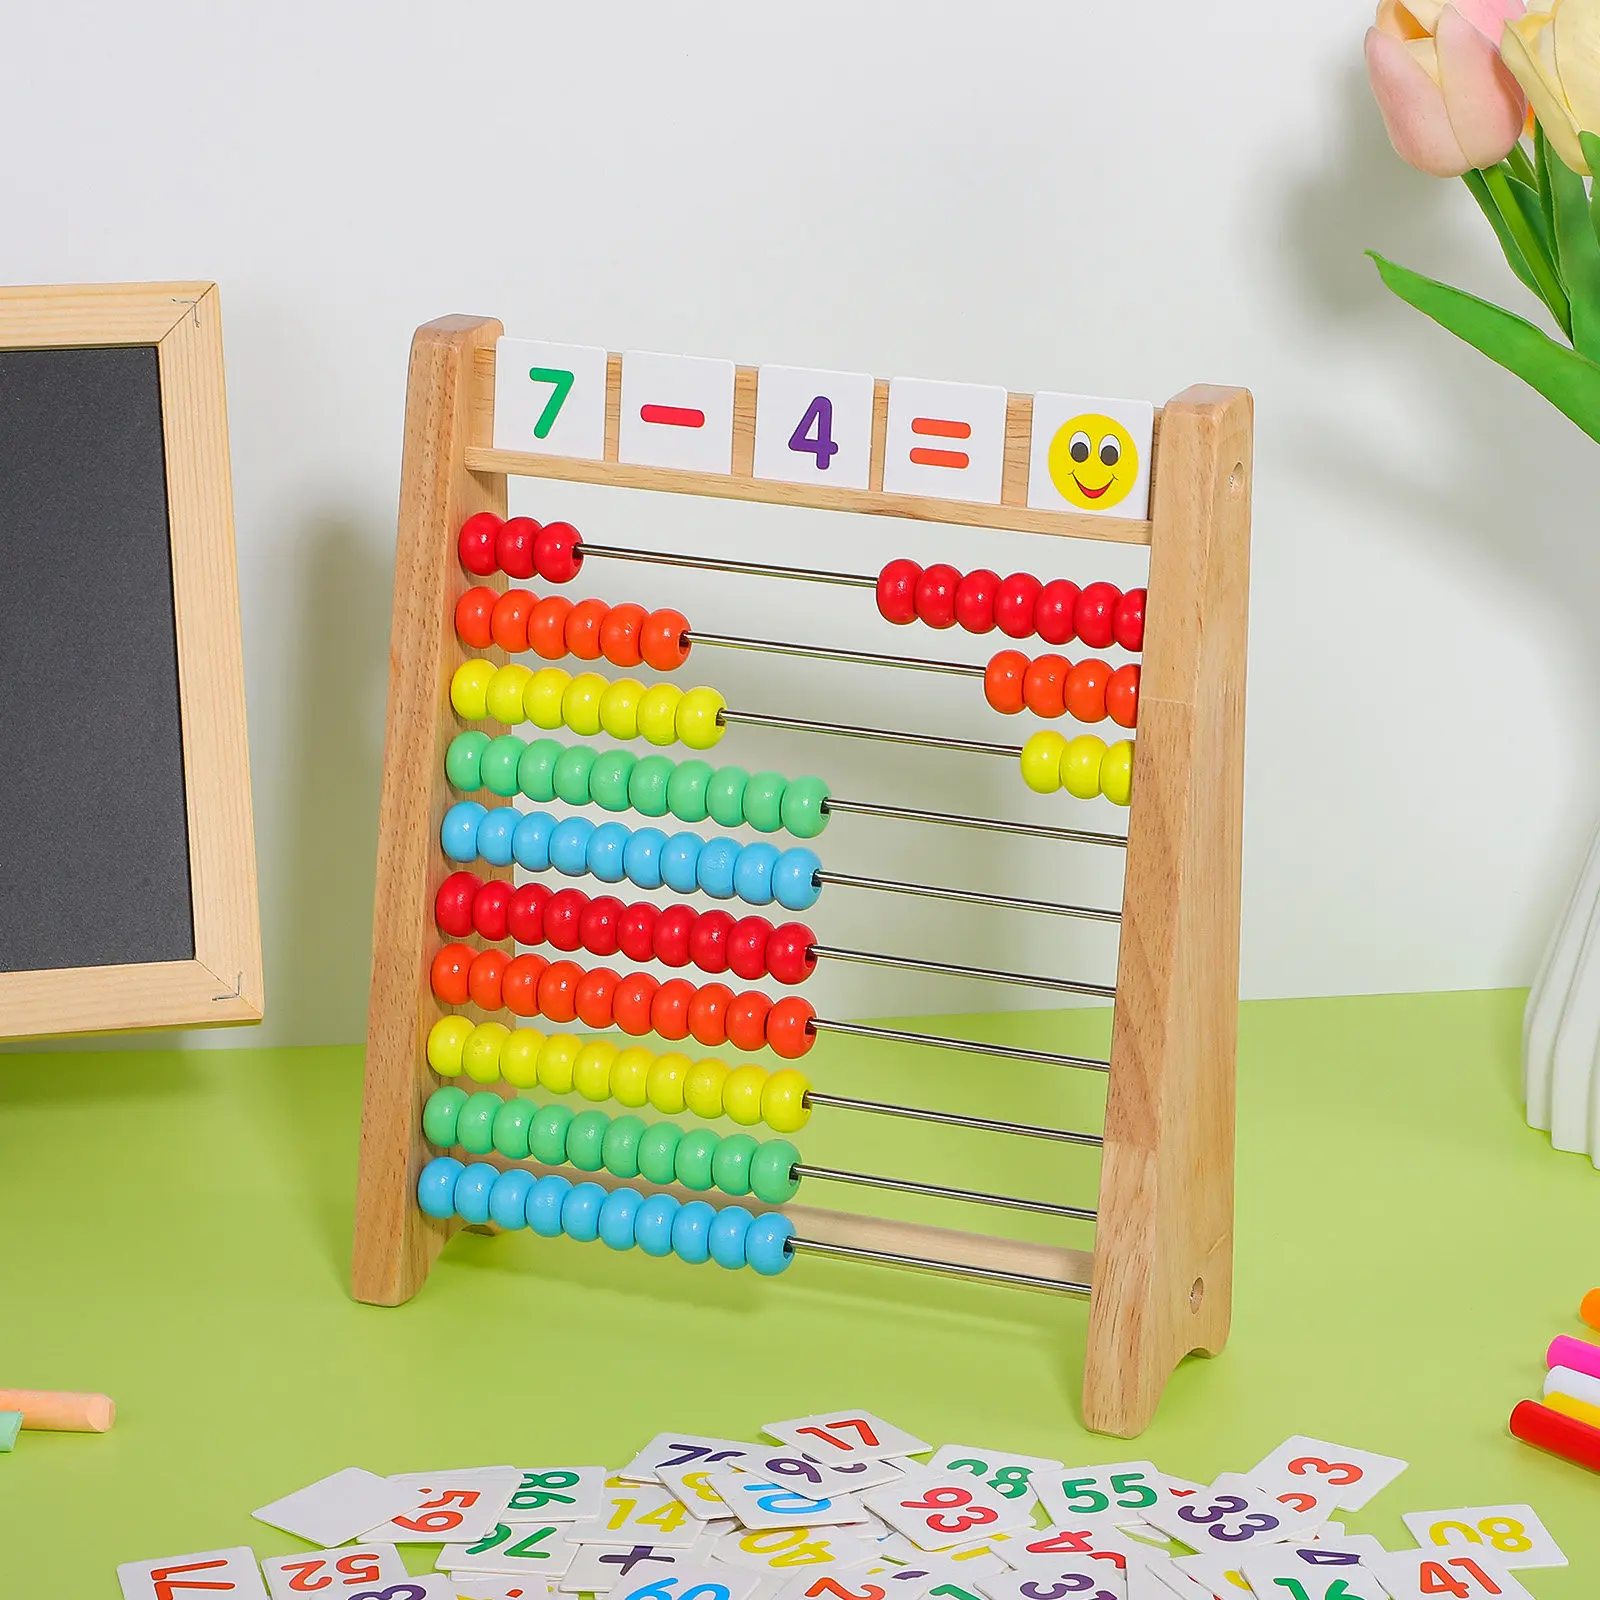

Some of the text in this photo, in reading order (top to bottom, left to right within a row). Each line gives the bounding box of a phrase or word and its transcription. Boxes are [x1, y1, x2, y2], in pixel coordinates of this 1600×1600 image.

[529, 367, 575, 440] 7
[787, 395, 839, 471] 4
[795, 1419, 880, 1451] 17
[1062, 1472, 1158, 1514] 55
[606, 1498, 686, 1532] 14
[1177, 1495, 1280, 1542] 33
[1419, 1557, 1503, 1599] 41
